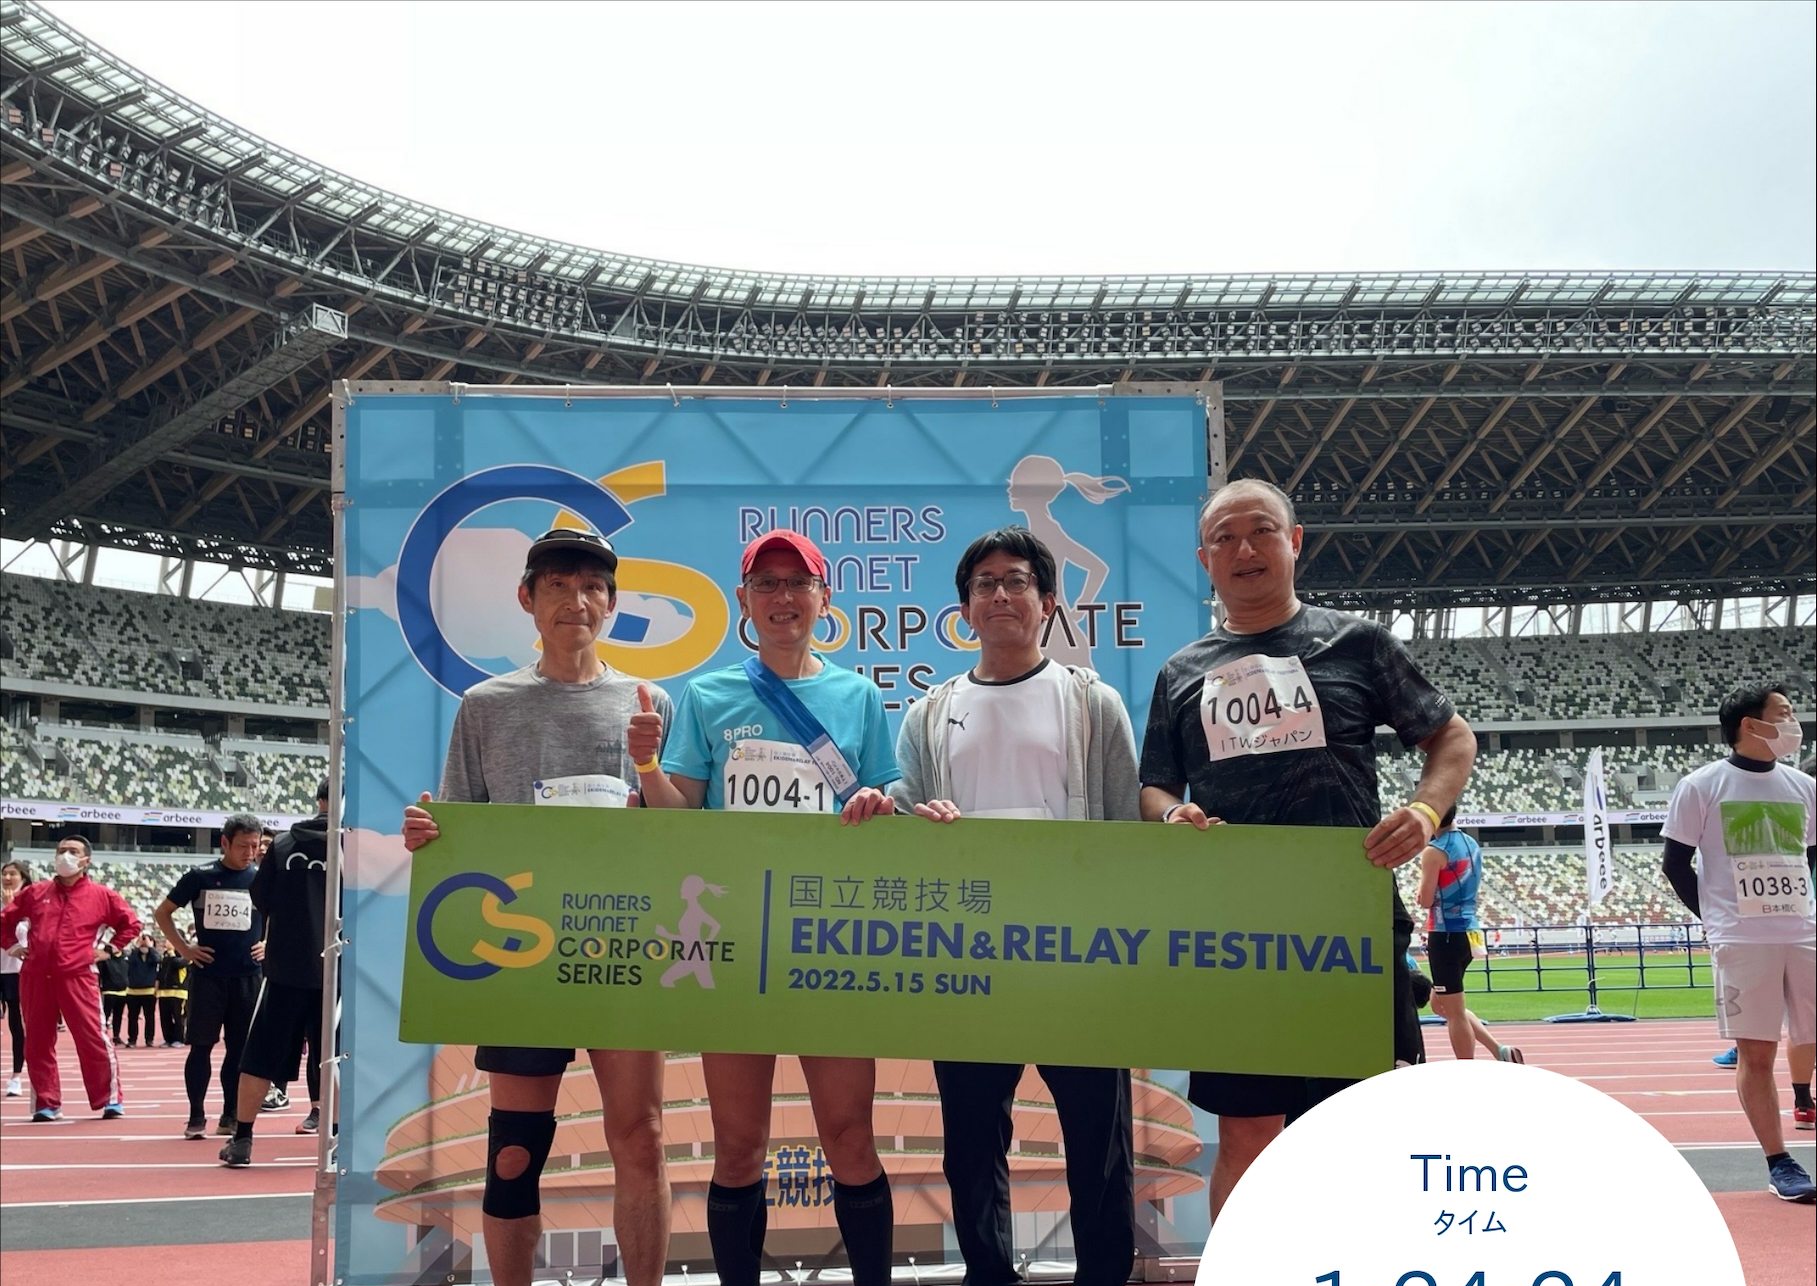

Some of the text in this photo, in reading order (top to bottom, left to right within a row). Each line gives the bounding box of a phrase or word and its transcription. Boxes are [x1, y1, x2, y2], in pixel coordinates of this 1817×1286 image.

[1207, 685, 1313, 725] 1004-4
[723, 724, 763, 742] 8PRO
[1221, 730, 1312, 752] ITWジャパン
[728, 773, 825, 811] 1004-1
[1, 803, 36, 815] rbeee
[80, 809, 121, 820] arbeee
[163, 813, 202, 823] arbeee
[1517, 815, 1547, 824] arbeee
[1456, 817, 1486, 825] arbeee
[1593, 813, 1607, 890] arbeee
[788, 873, 993, 915] 国立競技場
[1739, 876, 1808, 897] 1038-3
[206, 903, 250, 917] 1236-4
[561, 893, 652, 912] RUNNERS
[560, 914, 639, 933] RUNNET
[557, 936, 736, 963] CORPORATE
[789, 917, 1384, 975] EKIDEN&RELAY FESTIVAL
[556, 962, 643, 986] SERIES
[788, 967, 992, 996] 2022.5.15 SUN
